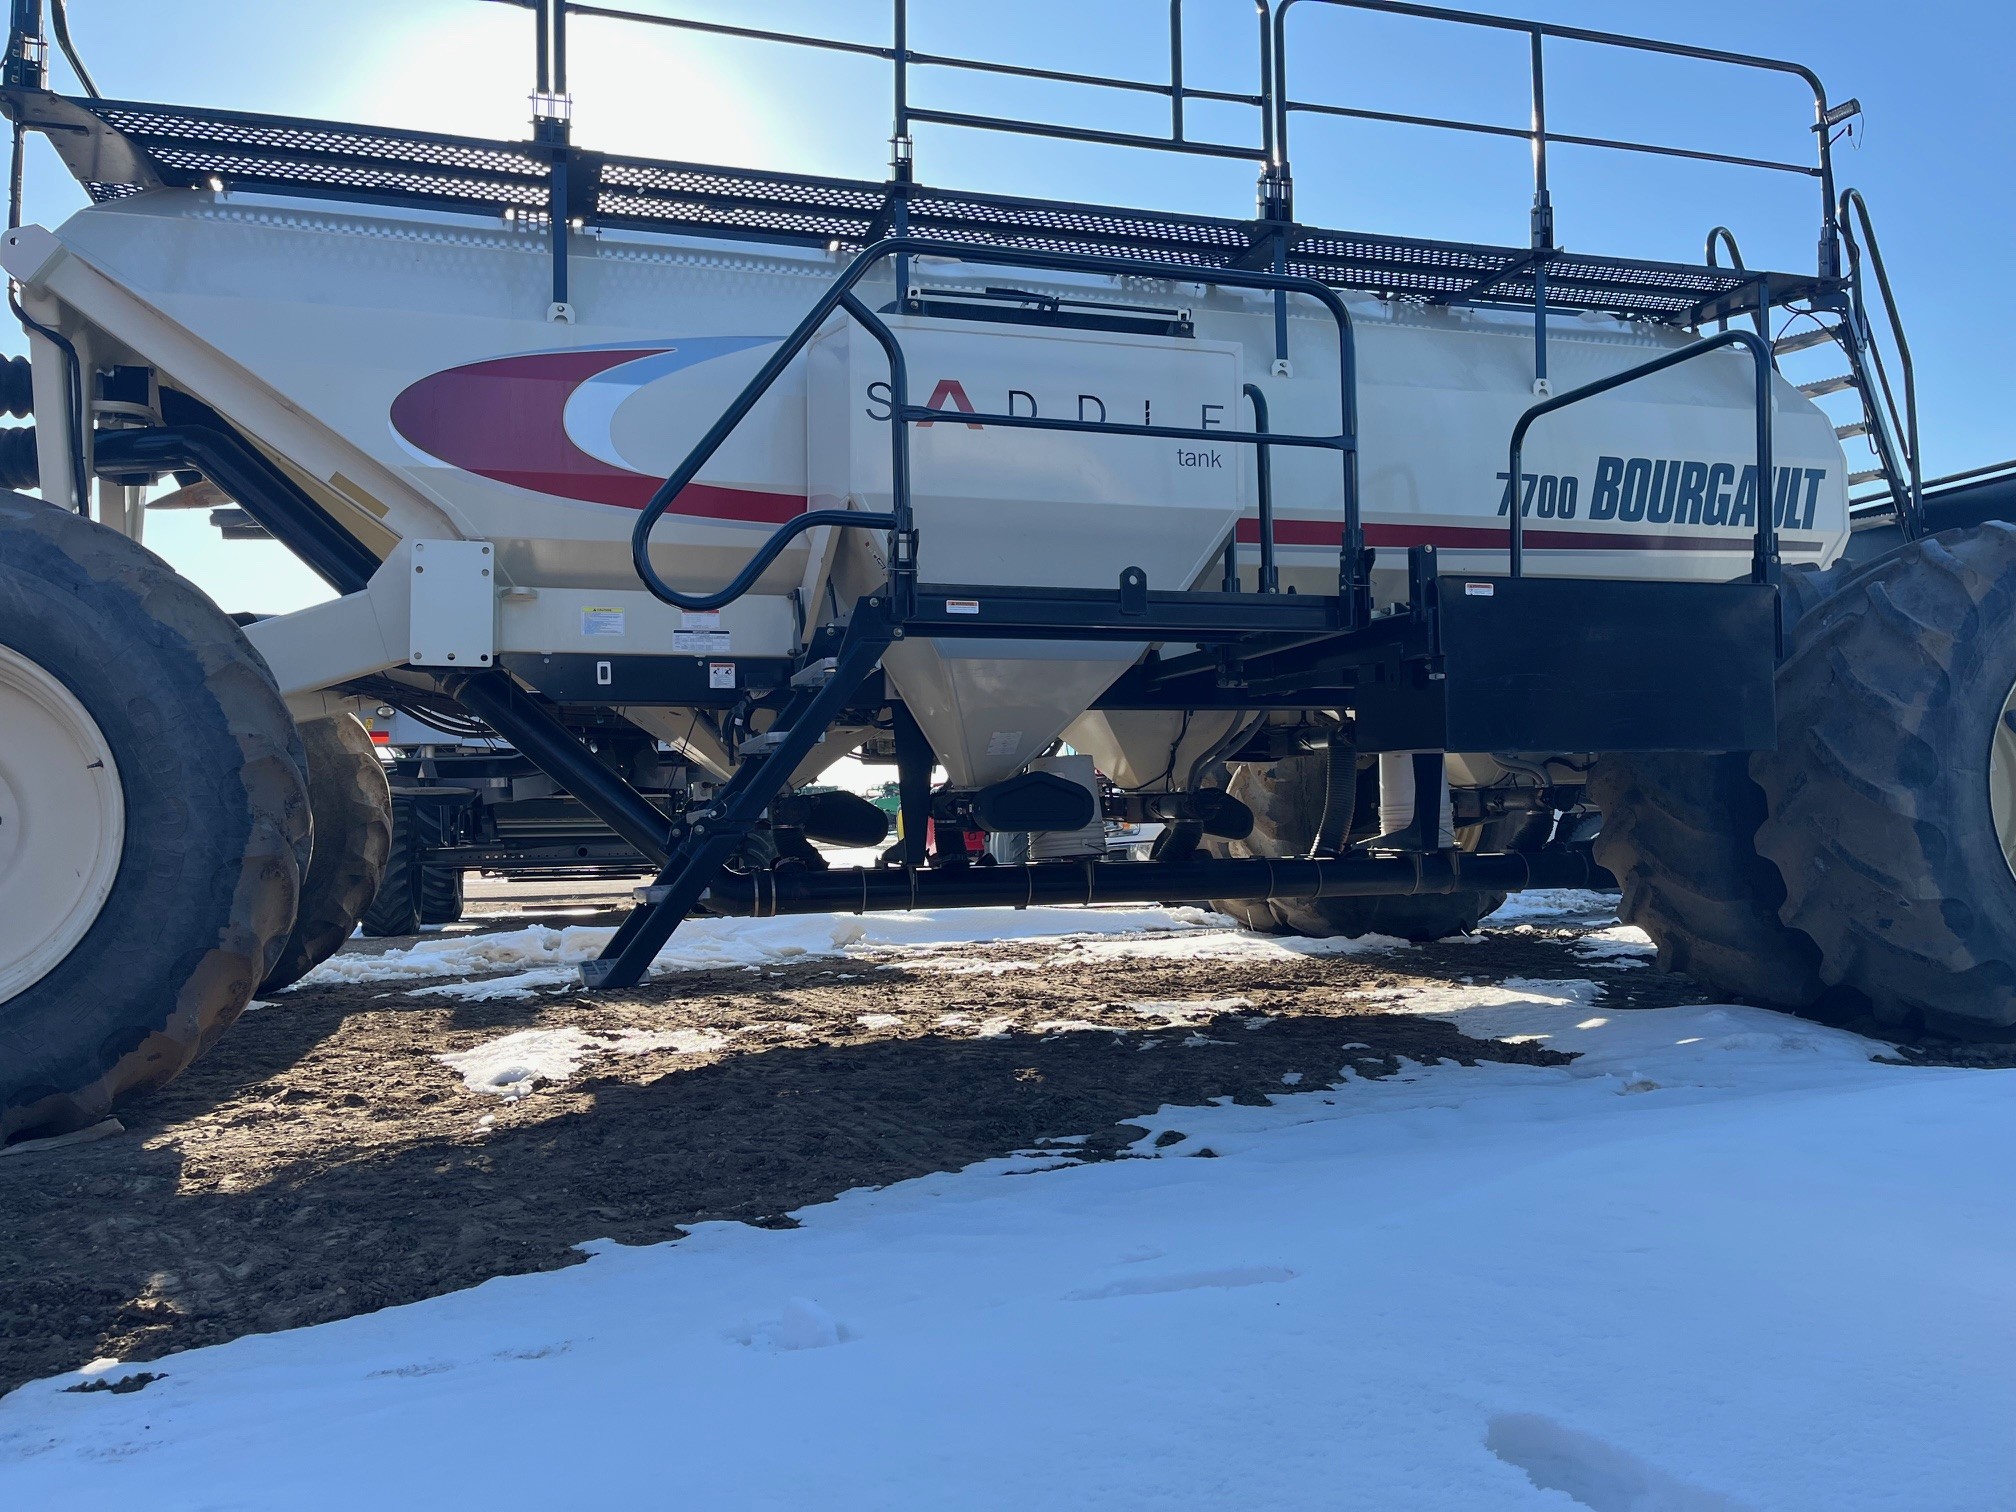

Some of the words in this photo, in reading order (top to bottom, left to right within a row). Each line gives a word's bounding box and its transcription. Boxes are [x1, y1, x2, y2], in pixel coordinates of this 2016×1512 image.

[1176, 448, 1222, 469] tank
[1495, 471, 1579, 520] 7700
[1588, 455, 1827, 530] BOURGAULT
